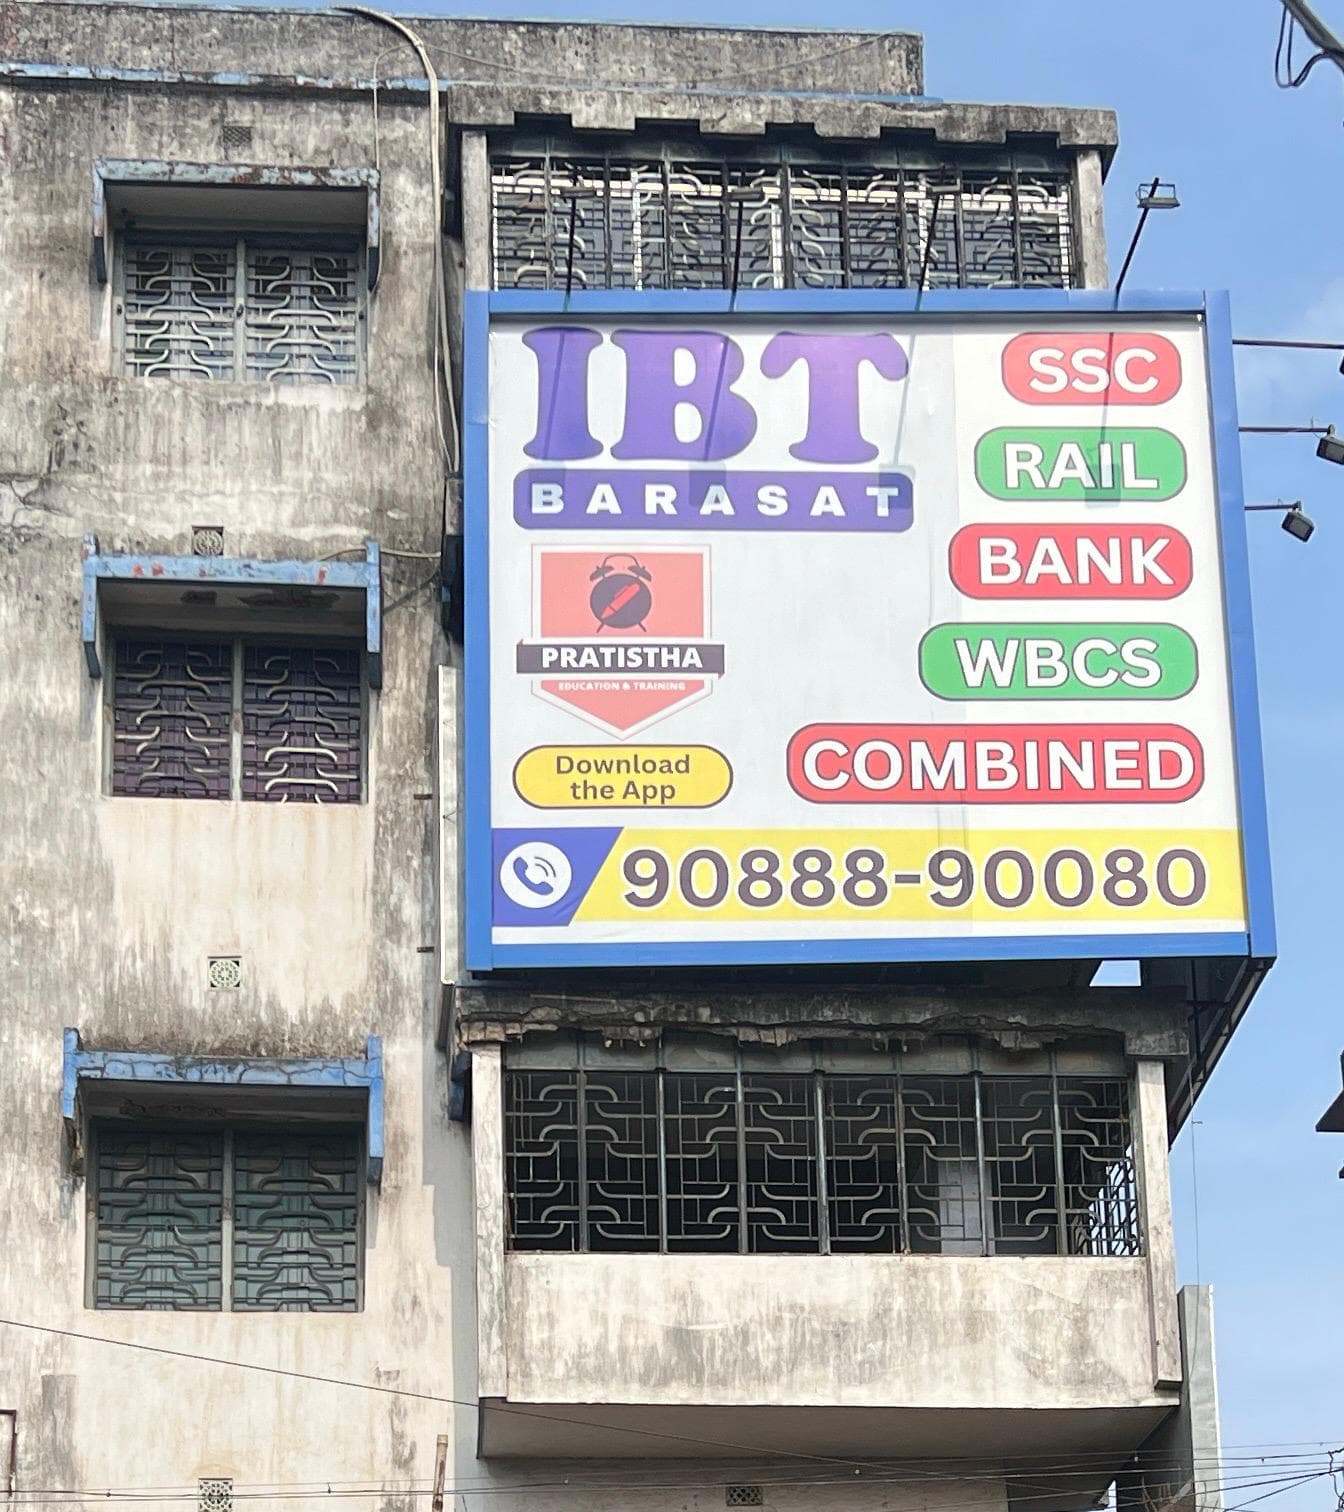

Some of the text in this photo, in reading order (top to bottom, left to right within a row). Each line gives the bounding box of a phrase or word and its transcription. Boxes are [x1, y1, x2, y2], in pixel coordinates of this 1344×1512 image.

[1028, 347, 1159, 394] SSC
[522, 327, 909, 464] IBT
[1004, 442, 1159, 489] RAIL
[531, 483, 898, 517] BARASAT
[978, 537, 1175, 585] BANK
[542, 647, 703, 668] PRATISTHA
[954, 637, 1163, 688] WBCS
[559, 682, 620, 691] EDUCATION
[634, 682, 686, 691] TRAINING
[556, 754, 690, 774] Download
[803, 739, 1196, 790] COMBINED
[570, 780, 675, 804] the App
[623, 848, 1206, 908] 90888-90080
